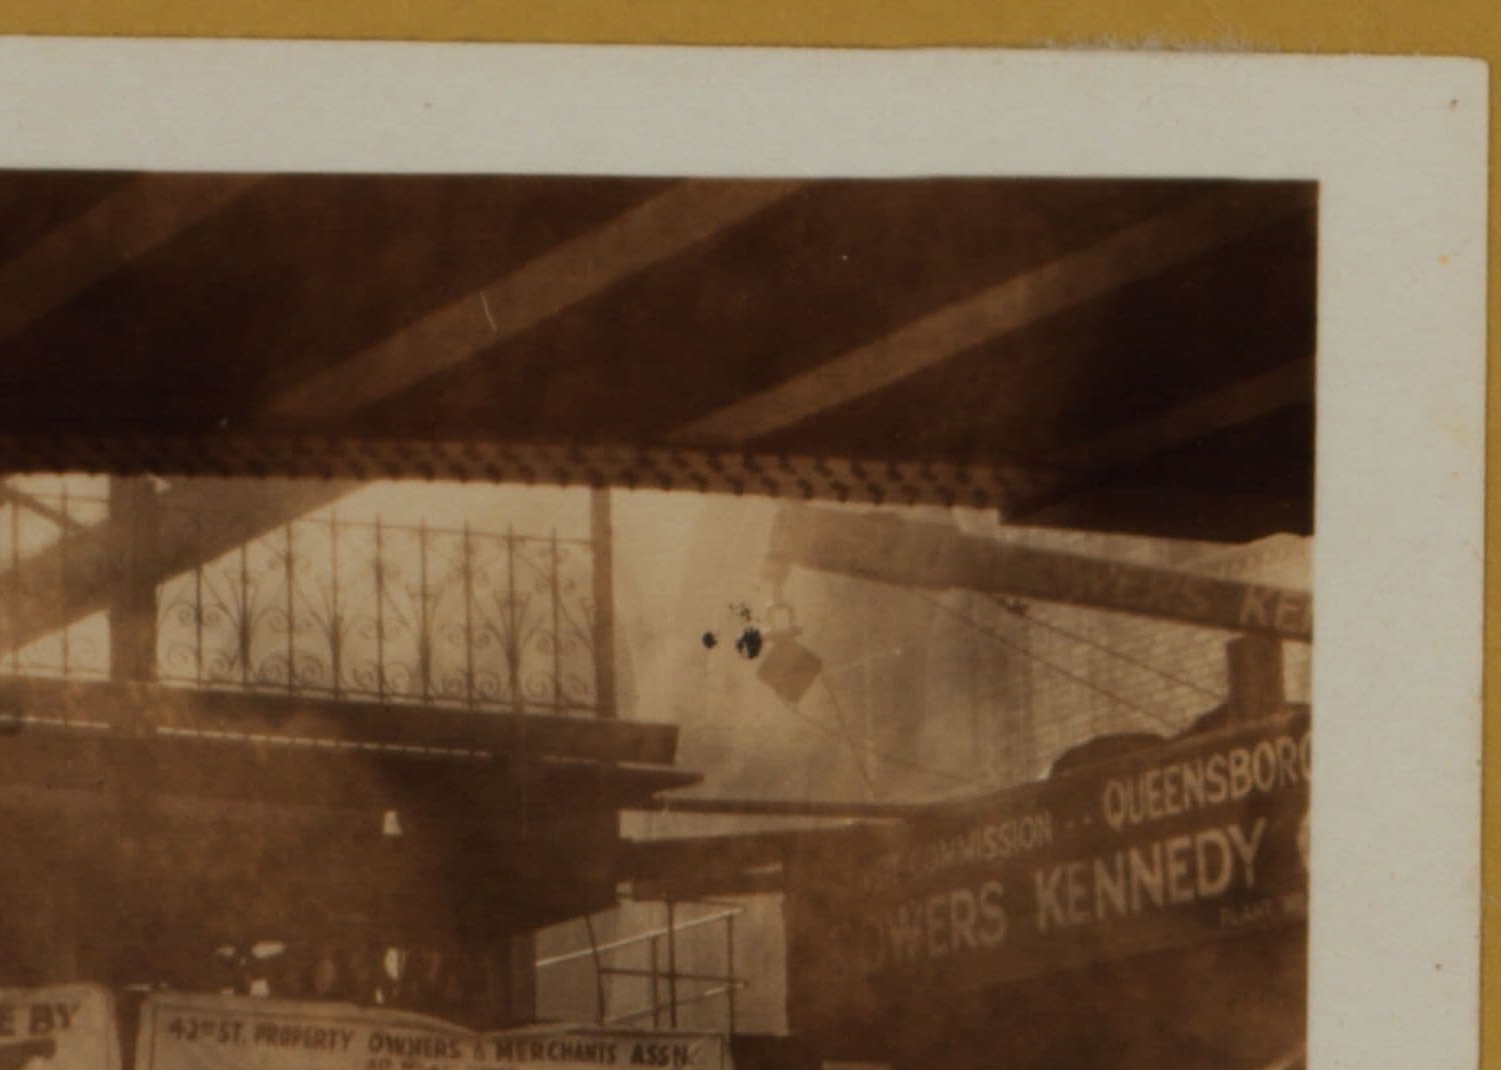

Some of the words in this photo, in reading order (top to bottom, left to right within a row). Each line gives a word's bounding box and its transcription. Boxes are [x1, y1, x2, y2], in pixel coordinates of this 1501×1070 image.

[1034, 816, 1268, 935] KENNEDY
[29, 1003, 81, 1035] BY
[253, 1022, 356, 1049] PROPERTY
[366, 1031, 462, 1059] OWNERS
[494, 1039, 618, 1064] MERCHANTS
